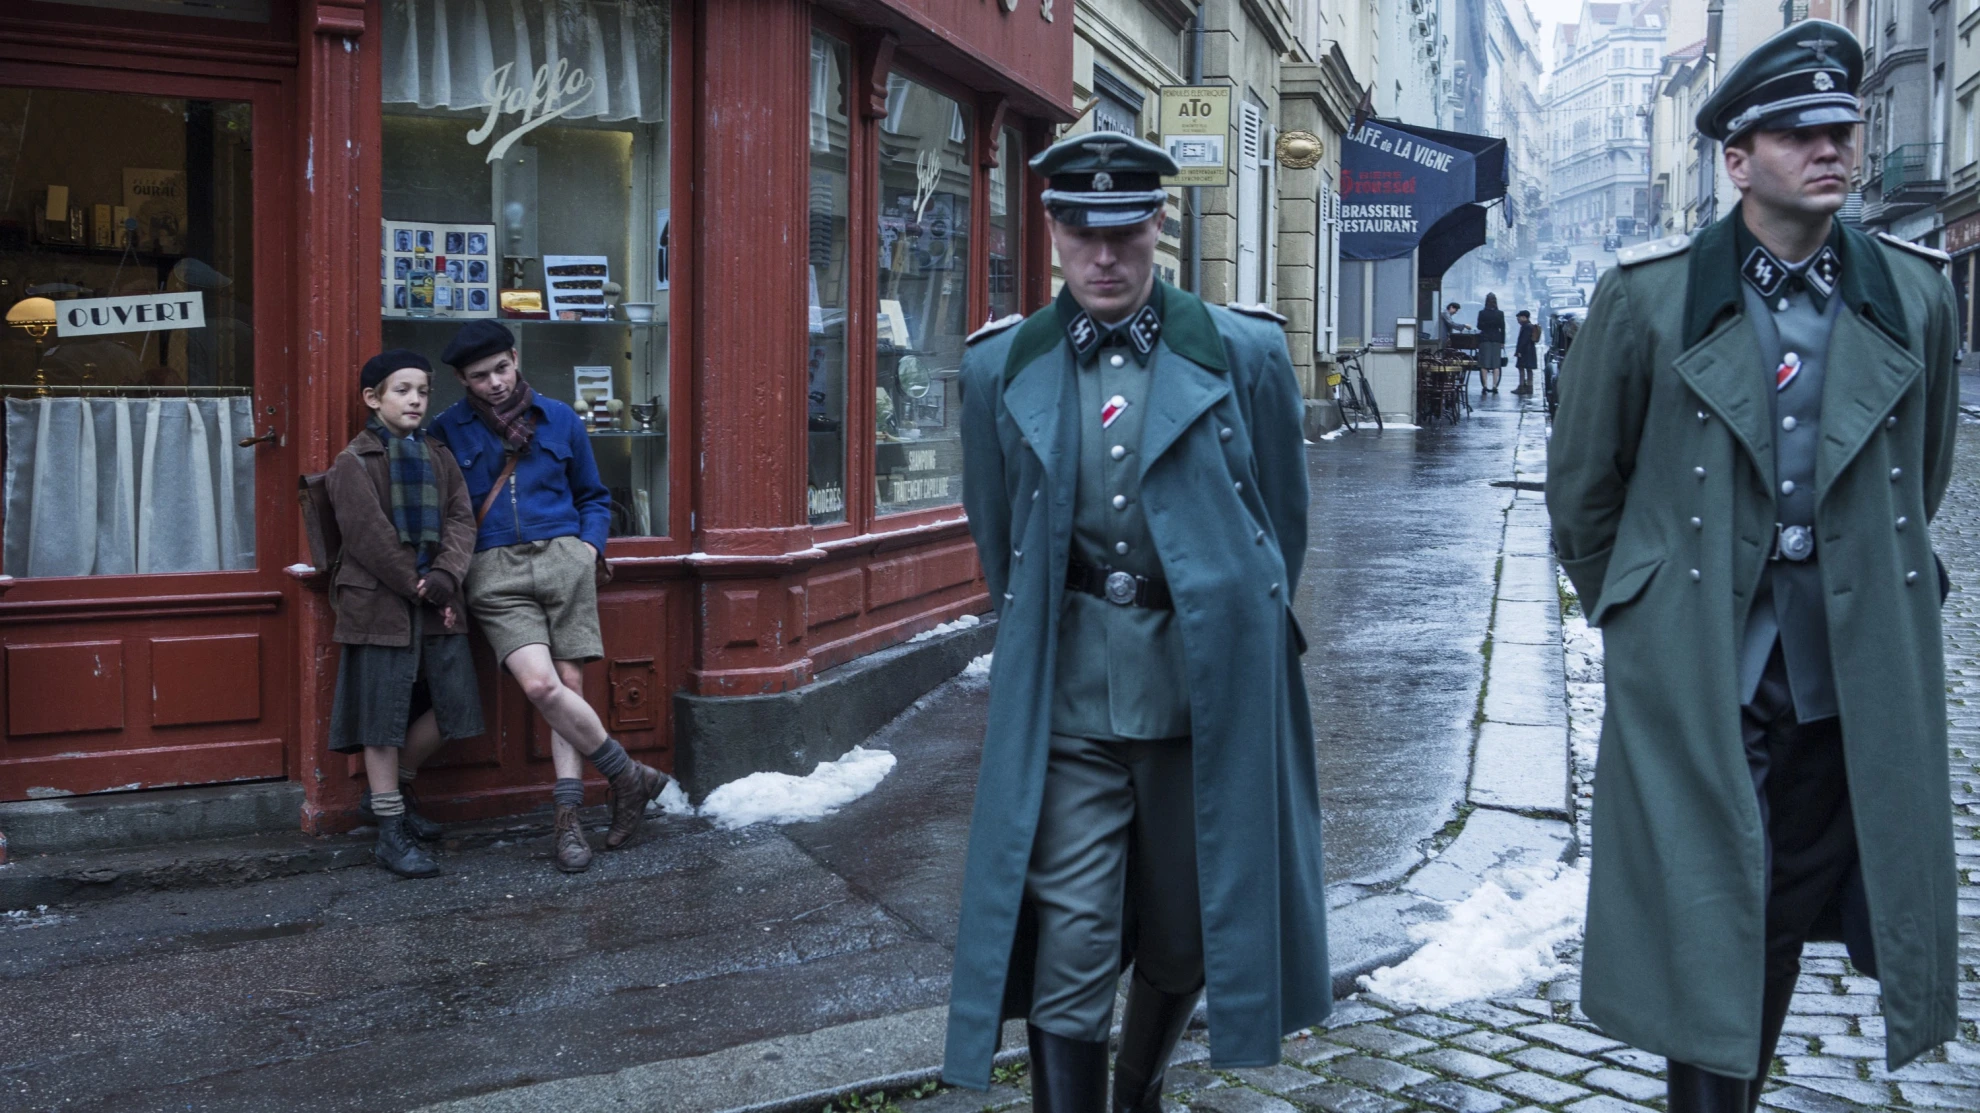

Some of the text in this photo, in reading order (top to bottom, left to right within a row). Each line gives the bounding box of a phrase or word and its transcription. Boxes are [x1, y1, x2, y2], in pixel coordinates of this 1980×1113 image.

[1178, 99, 1212, 117] ATO
[1380, 139, 1393, 153] de
[1393, 138, 1412, 159] LA
[1413, 144, 1454, 172] VIGNE
[1341, 205, 1412, 218] BRASSERIE
[68, 301, 193, 328] OUVERT
